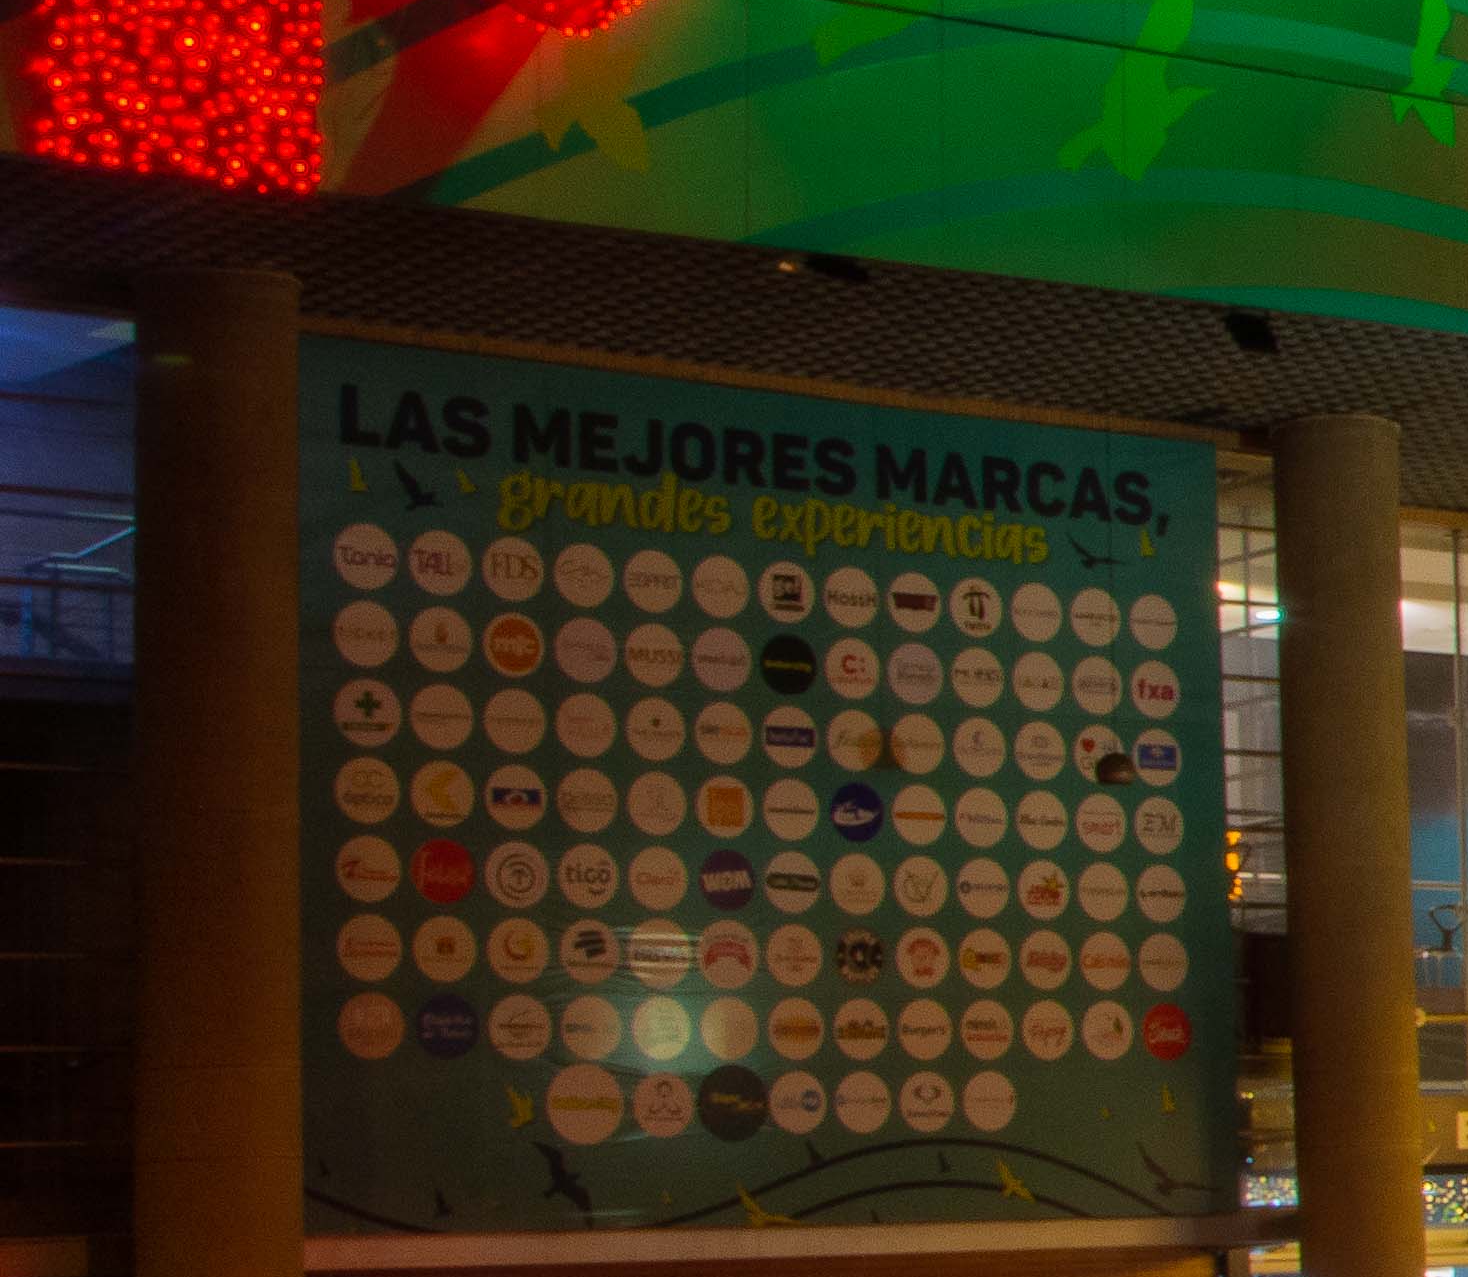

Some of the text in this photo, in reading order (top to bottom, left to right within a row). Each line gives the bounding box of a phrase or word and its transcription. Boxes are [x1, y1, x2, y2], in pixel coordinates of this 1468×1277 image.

[338, 384, 1172, 539] LAS MEJORES MARCAS,
[496, 470, 1052, 566] grandes experiencias
